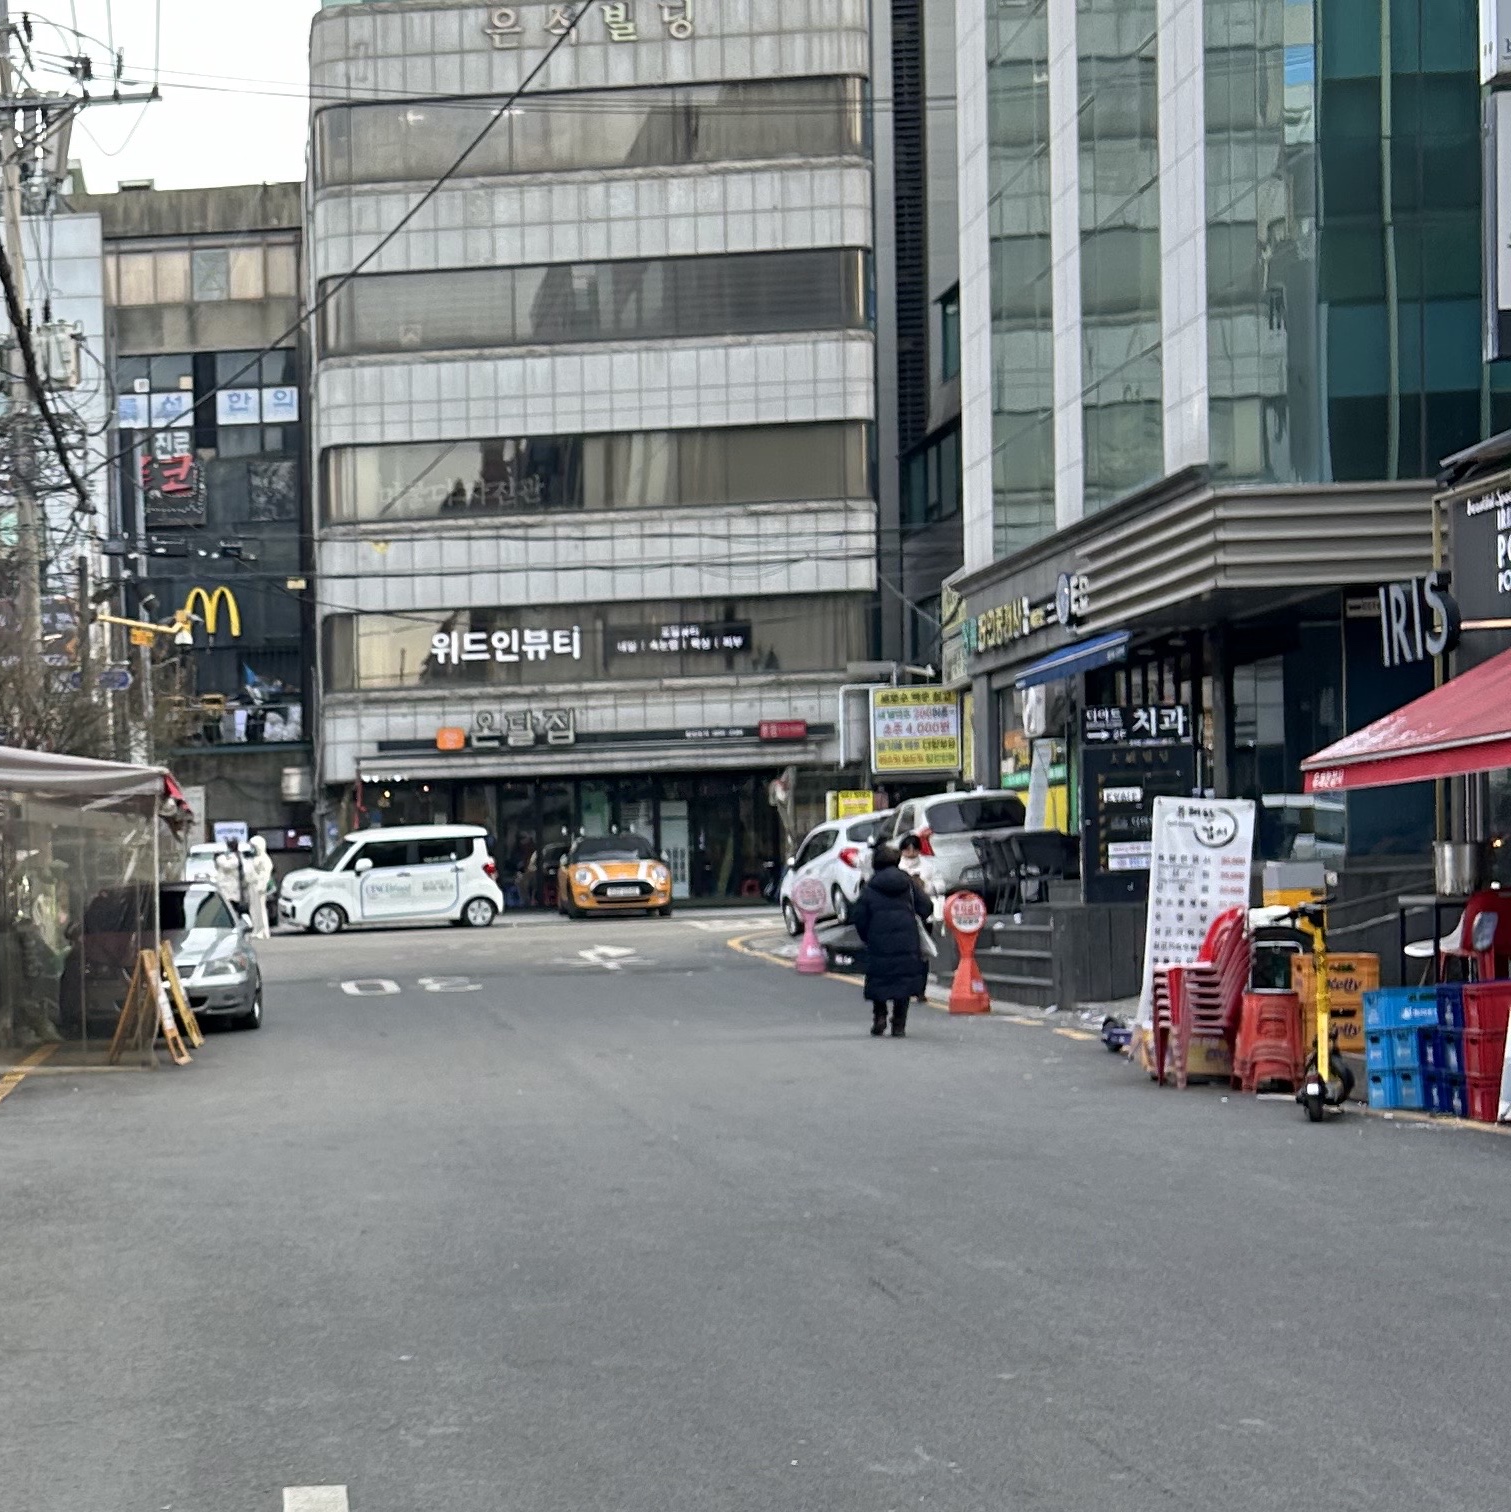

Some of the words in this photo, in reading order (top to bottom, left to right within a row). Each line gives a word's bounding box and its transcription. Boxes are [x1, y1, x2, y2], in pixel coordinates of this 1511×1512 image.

[1378, 570, 1448, 668] IRIS
[431, 624, 581, 666] 위드인뷰티
[1131, 705, 1188, 738] 치과
